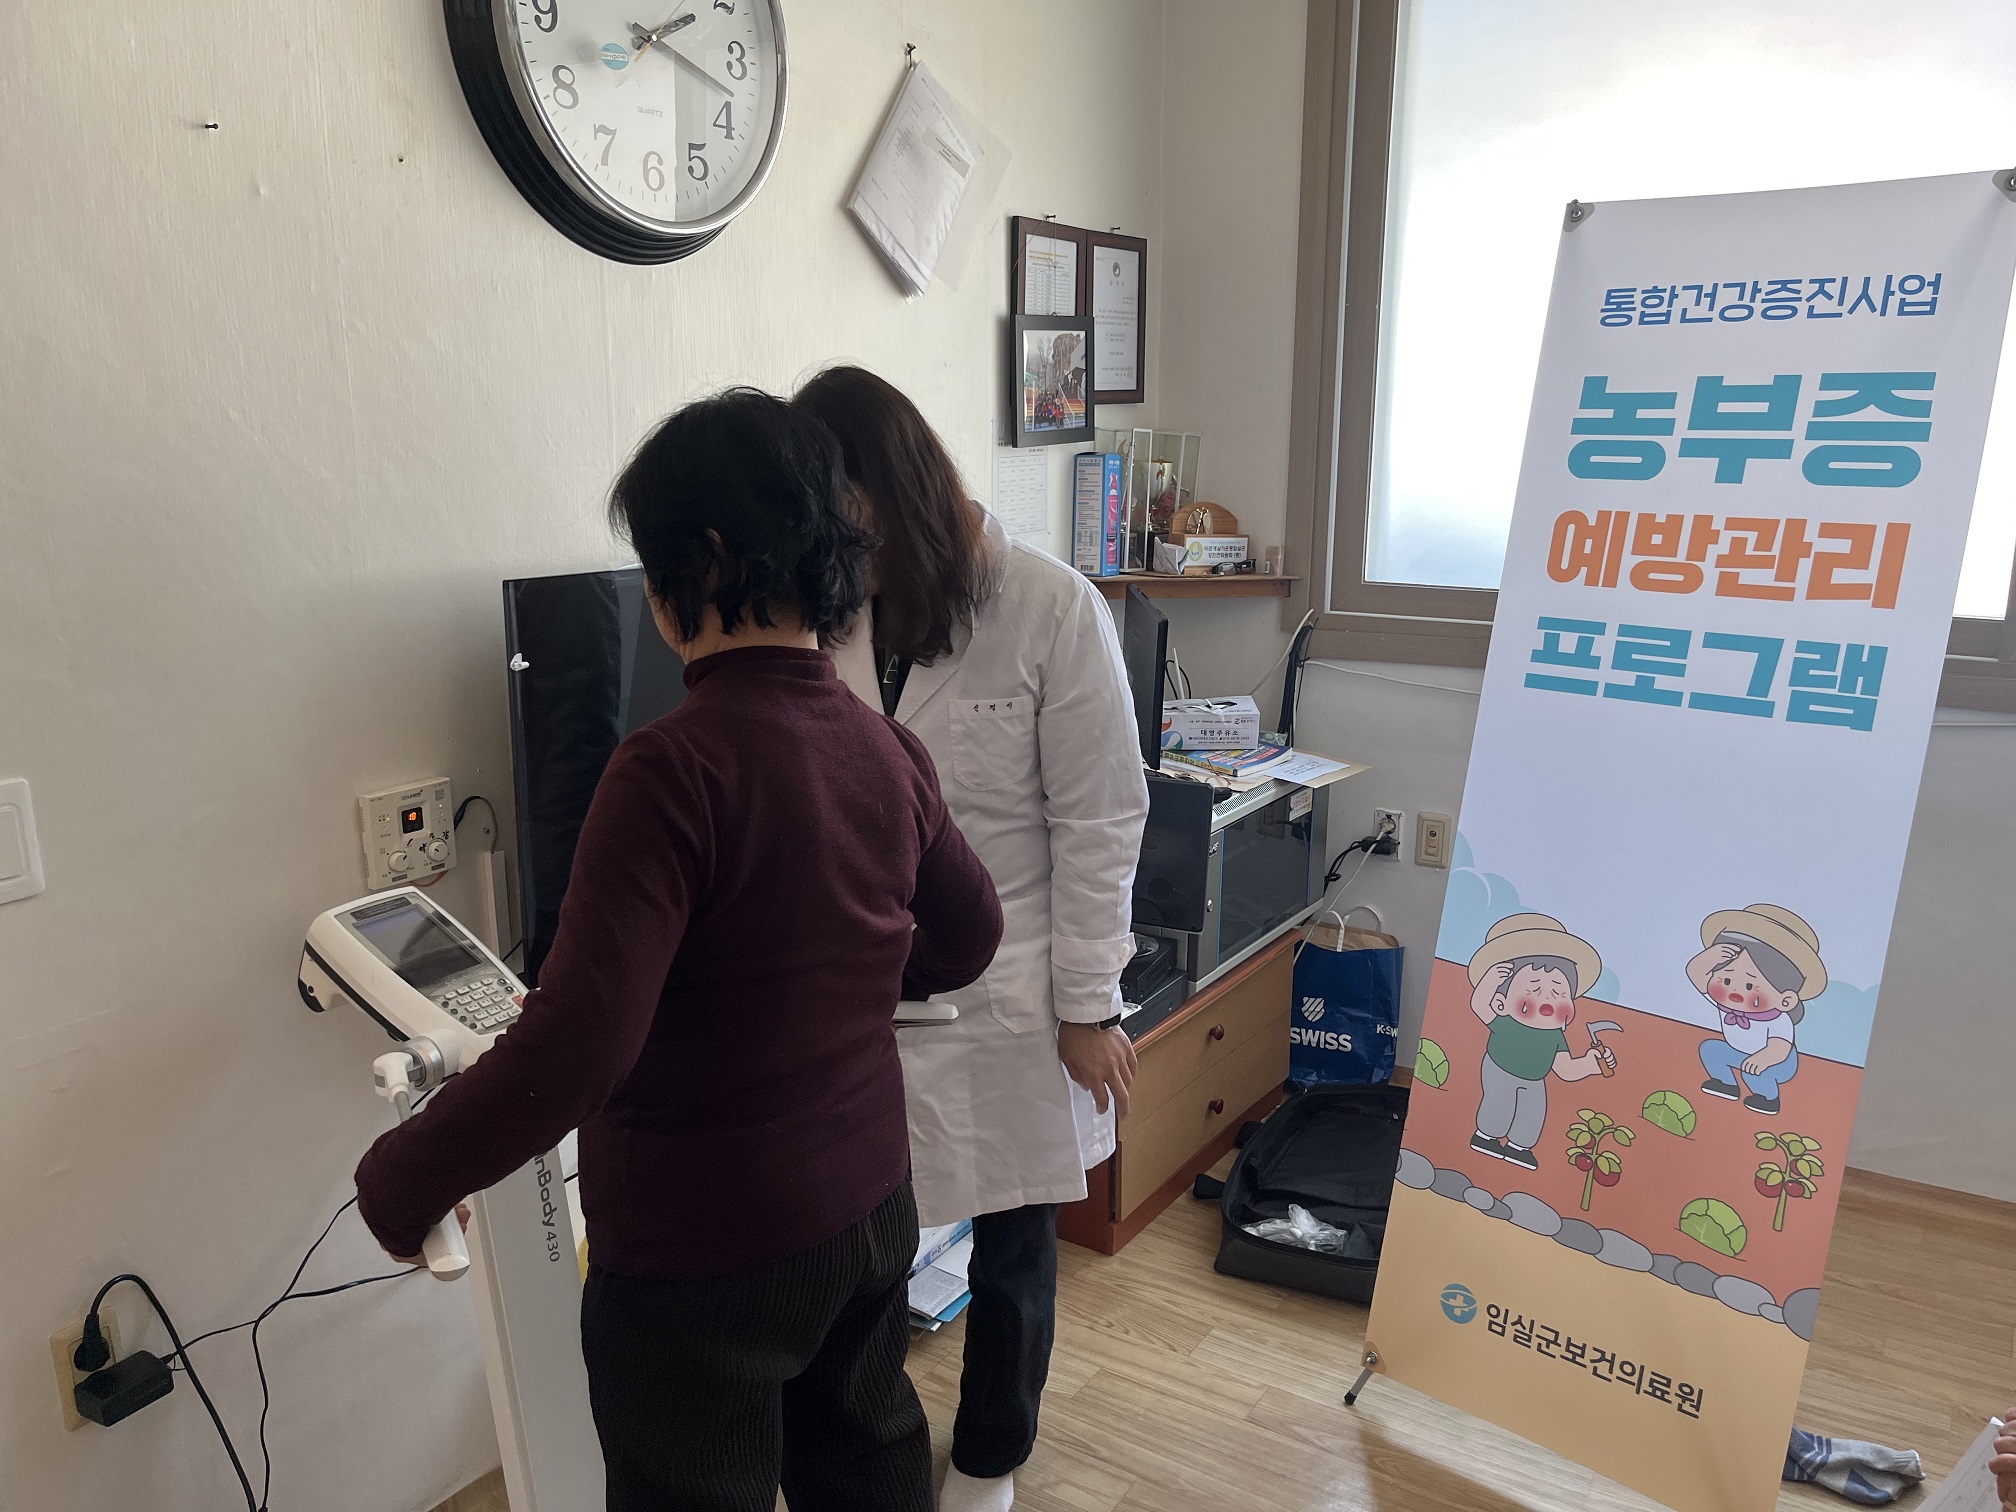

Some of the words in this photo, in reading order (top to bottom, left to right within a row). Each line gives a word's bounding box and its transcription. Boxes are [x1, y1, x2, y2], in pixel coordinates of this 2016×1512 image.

[726, 40, 748, 81] 3
[551, 64, 580, 110] 8
[637, 106, 664, 118] QUARTZ
[712, 100, 735, 140] 4
[592, 123, 618, 167] 7
[687, 142, 709, 181] 5
[642, 150, 665, 192] 6
[1598, 273, 1943, 328] 통합건강증진사업
[1567, 371, 1937, 489] 농부증
[1546, 509, 1912, 610] 예방관리
[1523, 616, 1889, 732] 프로그램
[1200, 729, 1239, 737] 대영주유소
[1290, 1027, 1352, 1052] SWISS
[546, 1231, 561, 1263] 430
[1486, 1303, 1704, 1419] 임실군보건의료원
